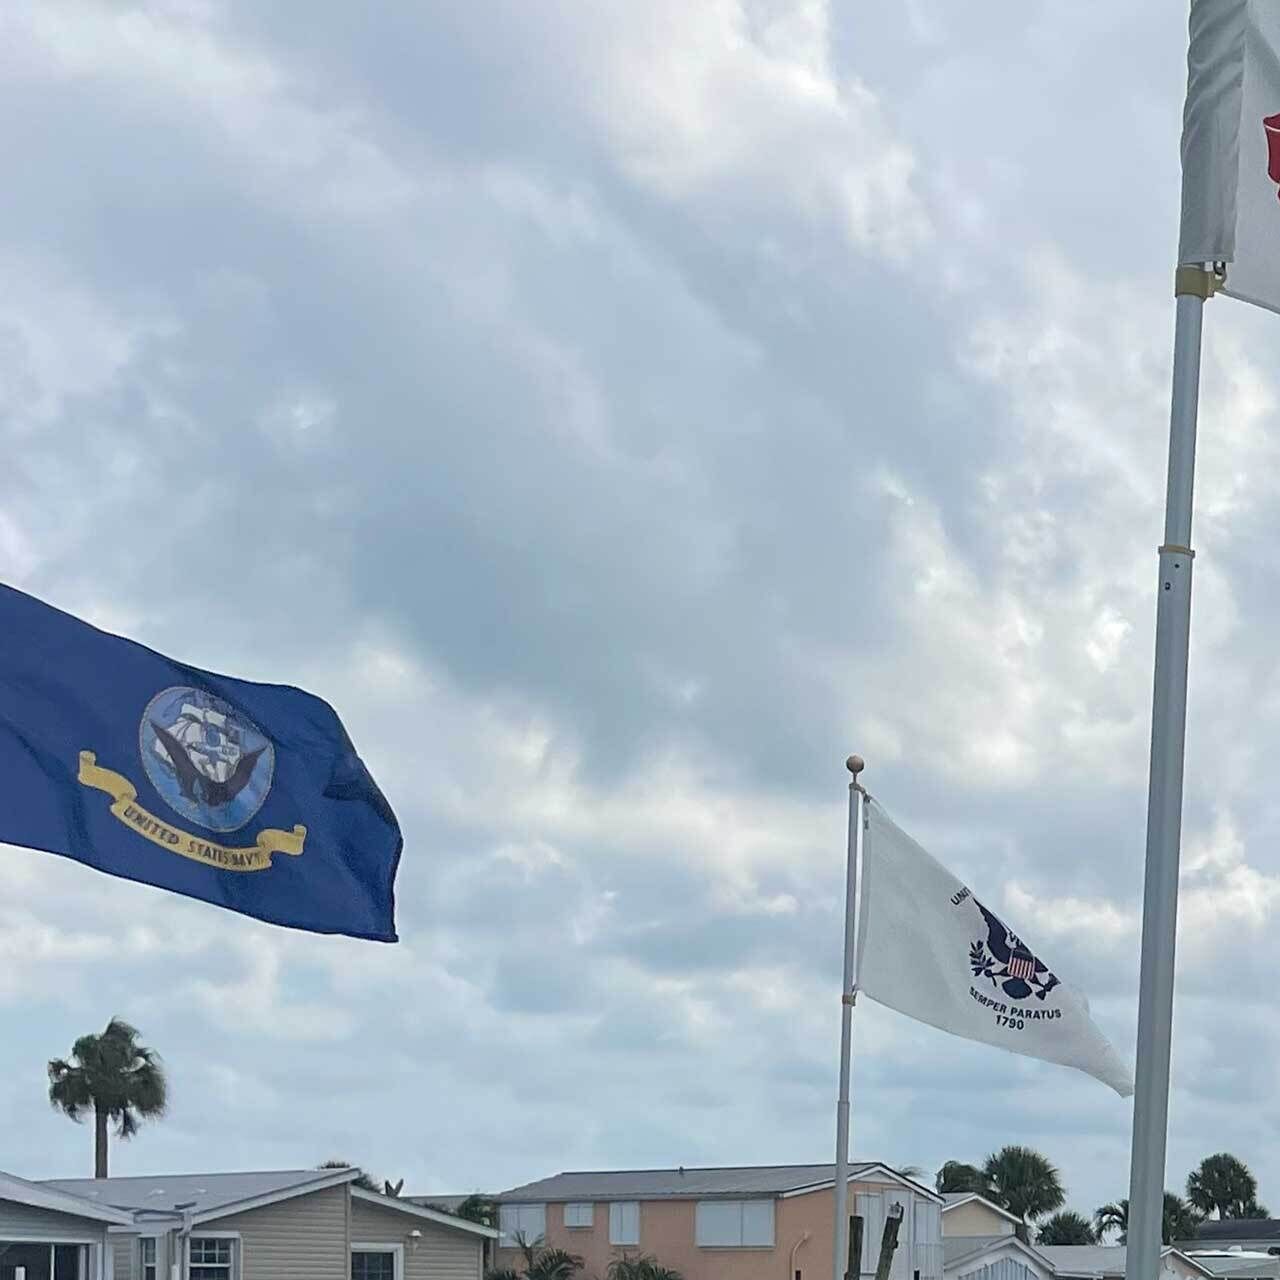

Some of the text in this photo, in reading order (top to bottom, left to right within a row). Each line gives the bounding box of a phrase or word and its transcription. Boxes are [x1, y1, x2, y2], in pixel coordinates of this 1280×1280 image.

[123, 805, 180, 844] UNITED
[969, 986, 1062, 1020] SEMPER PARATUS
[995, 1014, 1025, 1031] 1790
